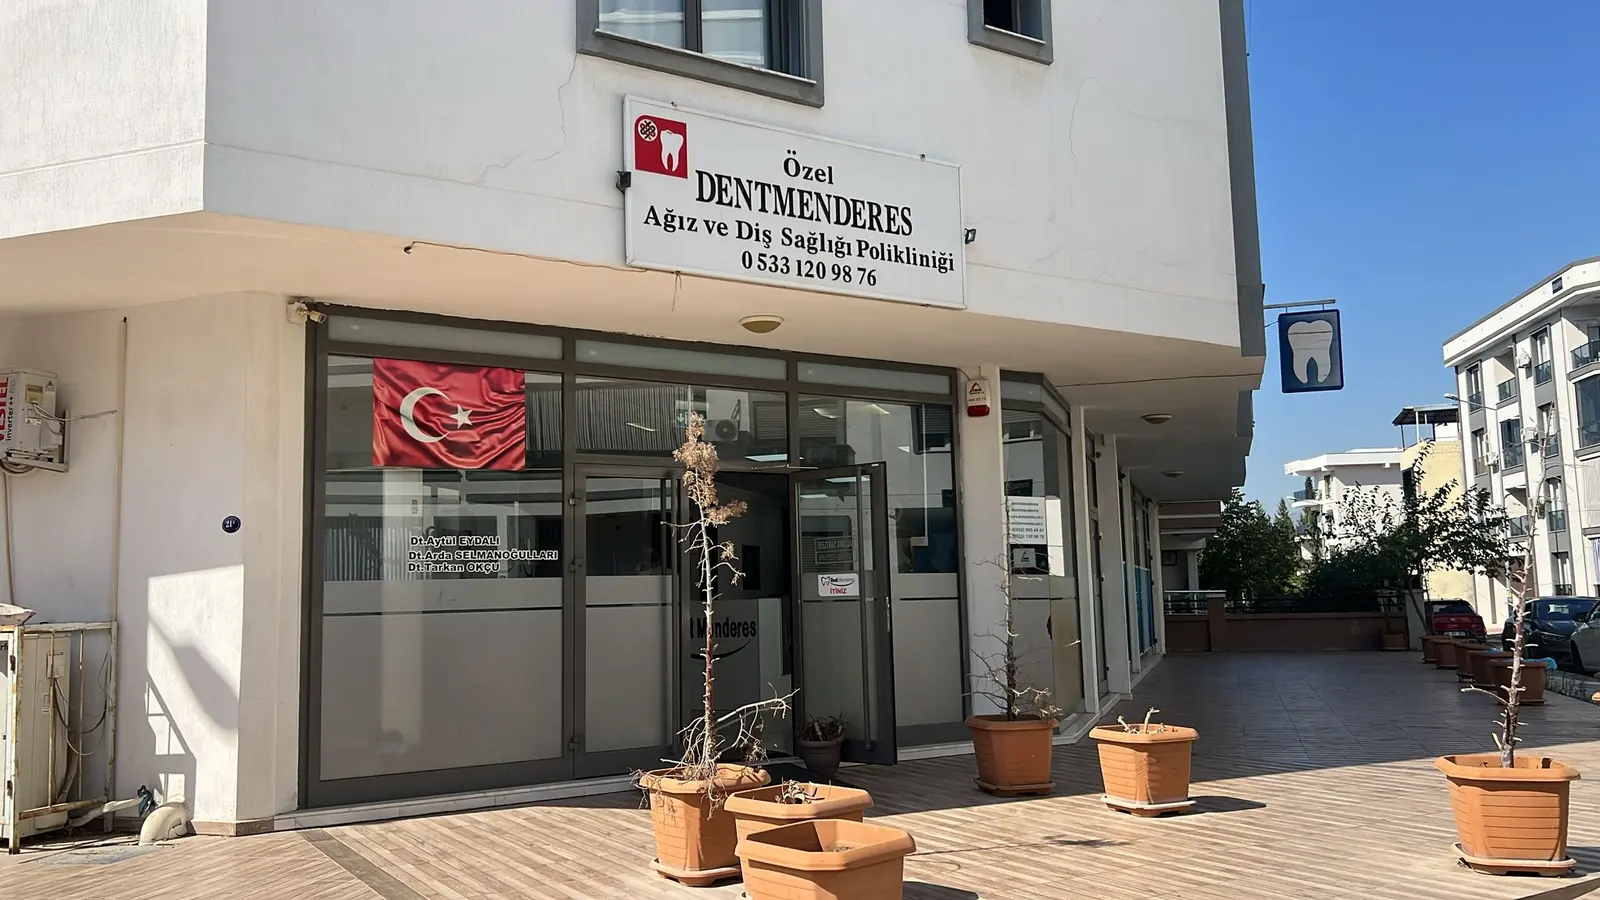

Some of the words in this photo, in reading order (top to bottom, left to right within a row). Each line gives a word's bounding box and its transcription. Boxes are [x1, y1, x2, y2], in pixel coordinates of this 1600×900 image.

[783, 149, 834, 185] Özel
[695, 169, 913, 237] DENTMENDERES
[643, 205, 698, 233] Ağız
[702, 218, 729, 237] ve
[735, 219, 772, 248] Diş
[780, 227, 853, 258] Sağlığı
[855, 239, 955, 274] Polikliniği
[741, 250, 753, 270] 0
[757, 252, 791, 275] 533
[796, 258, 827, 280] 120
[831, 263, 853, 283] 98
[857, 267, 877, 287] 76
[408, 550, 453, 560] Dt.Arda
[454, 548, 559, 560] SELMANOĞULLARI
[410, 536, 457, 548] Dt.Aytül
[458, 536, 500, 546] EYDALI
[408, 561, 465, 572] Dt.Tarkan
[466, 562, 500, 574] OKÇU
[696, 616, 757, 639] Mnderes
